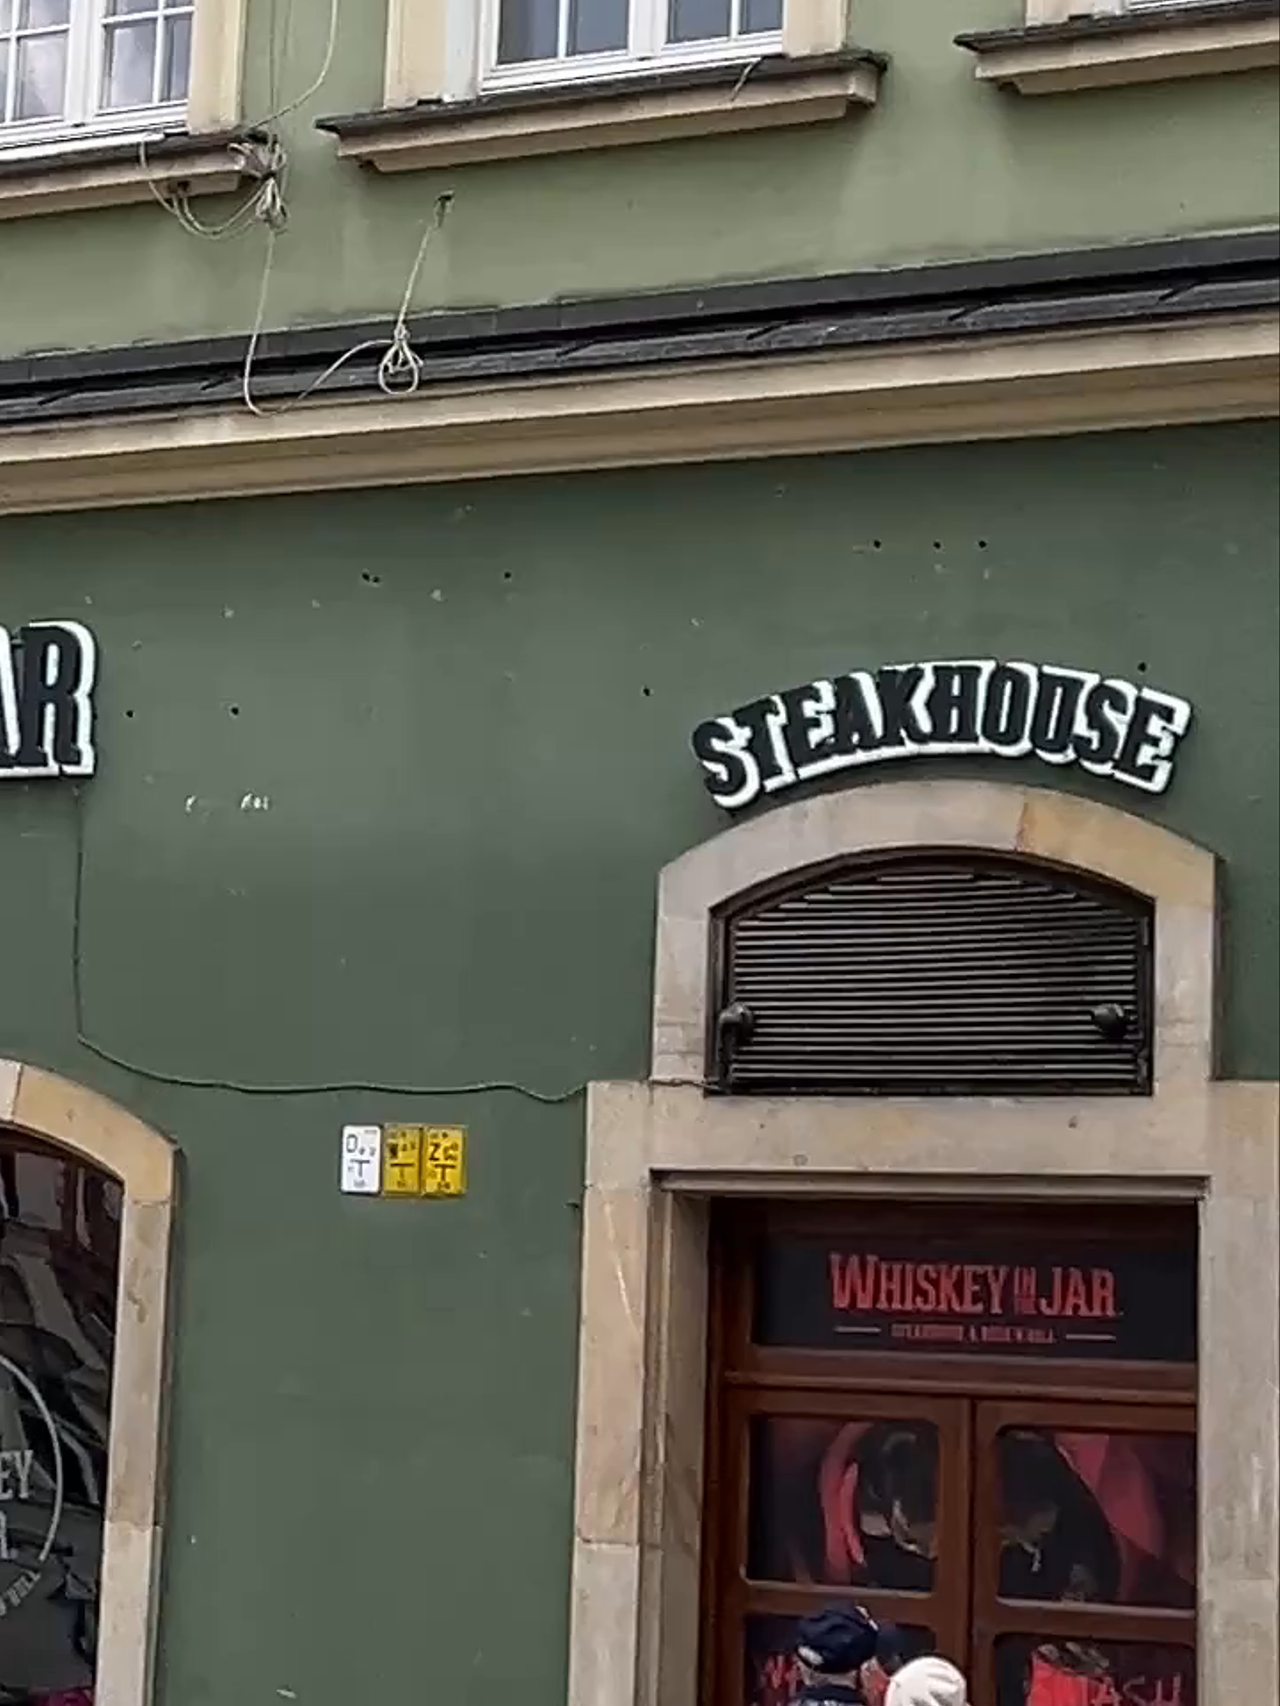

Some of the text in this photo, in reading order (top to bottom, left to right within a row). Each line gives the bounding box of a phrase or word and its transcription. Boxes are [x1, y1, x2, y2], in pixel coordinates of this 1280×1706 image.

[691, 657, 1194, 810] STEAKHOUSE
[828, 1252, 1010, 1315] WHISKEY
[1039, 1266, 1118, 1317] JAR
